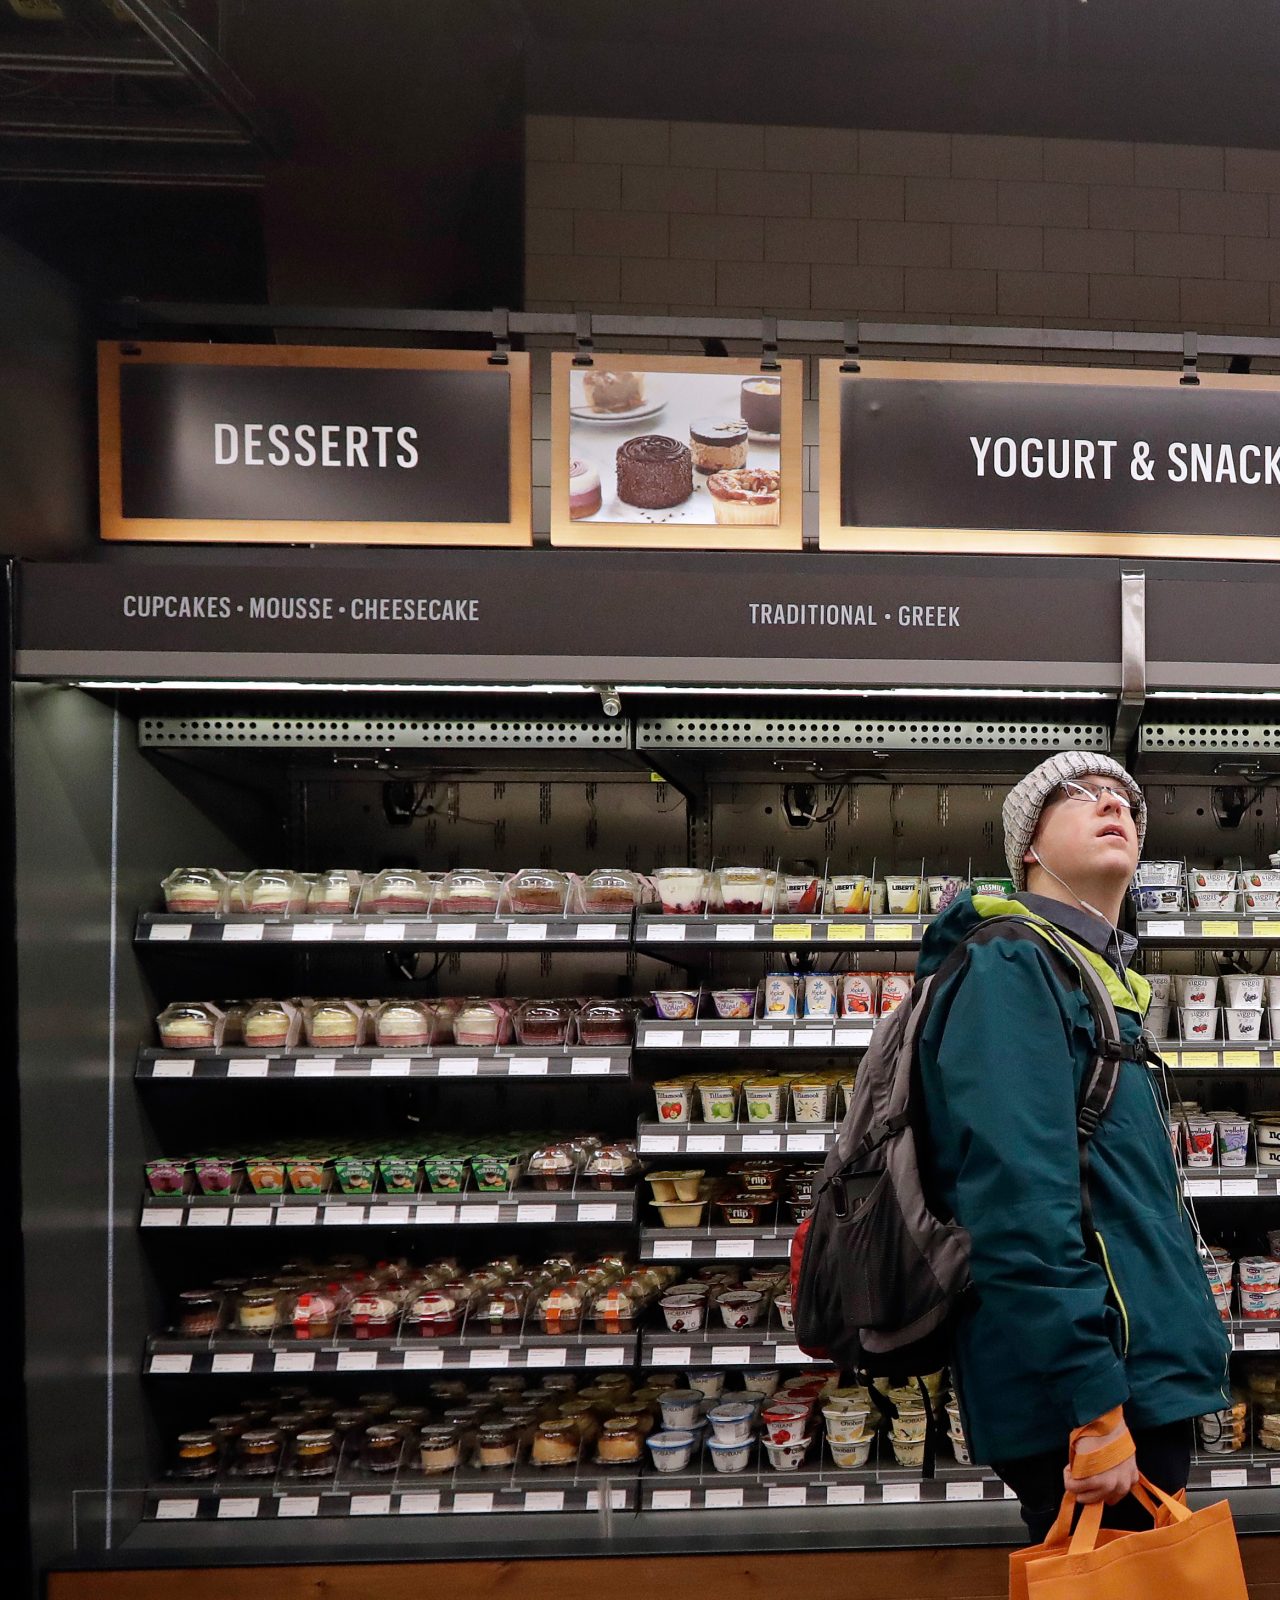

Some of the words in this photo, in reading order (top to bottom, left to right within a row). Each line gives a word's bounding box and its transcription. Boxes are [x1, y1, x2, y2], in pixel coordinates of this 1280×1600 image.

[213, 422, 420, 470] DESSERTS
[970, 437, 1117, 480] YOGURT
[1130, 441, 1155, 481] &
[123, 596, 231, 619] CUPCAKES
[249, 598, 334, 620] MOUSSE
[350, 599, 480, 621] CHEESECAKE
[748, 604, 878, 626] TRADITIONAL
[898, 606, 961, 627] GREEK
[750, 1176, 767, 1185] flip
[732, 1208, 749, 1218] flip
